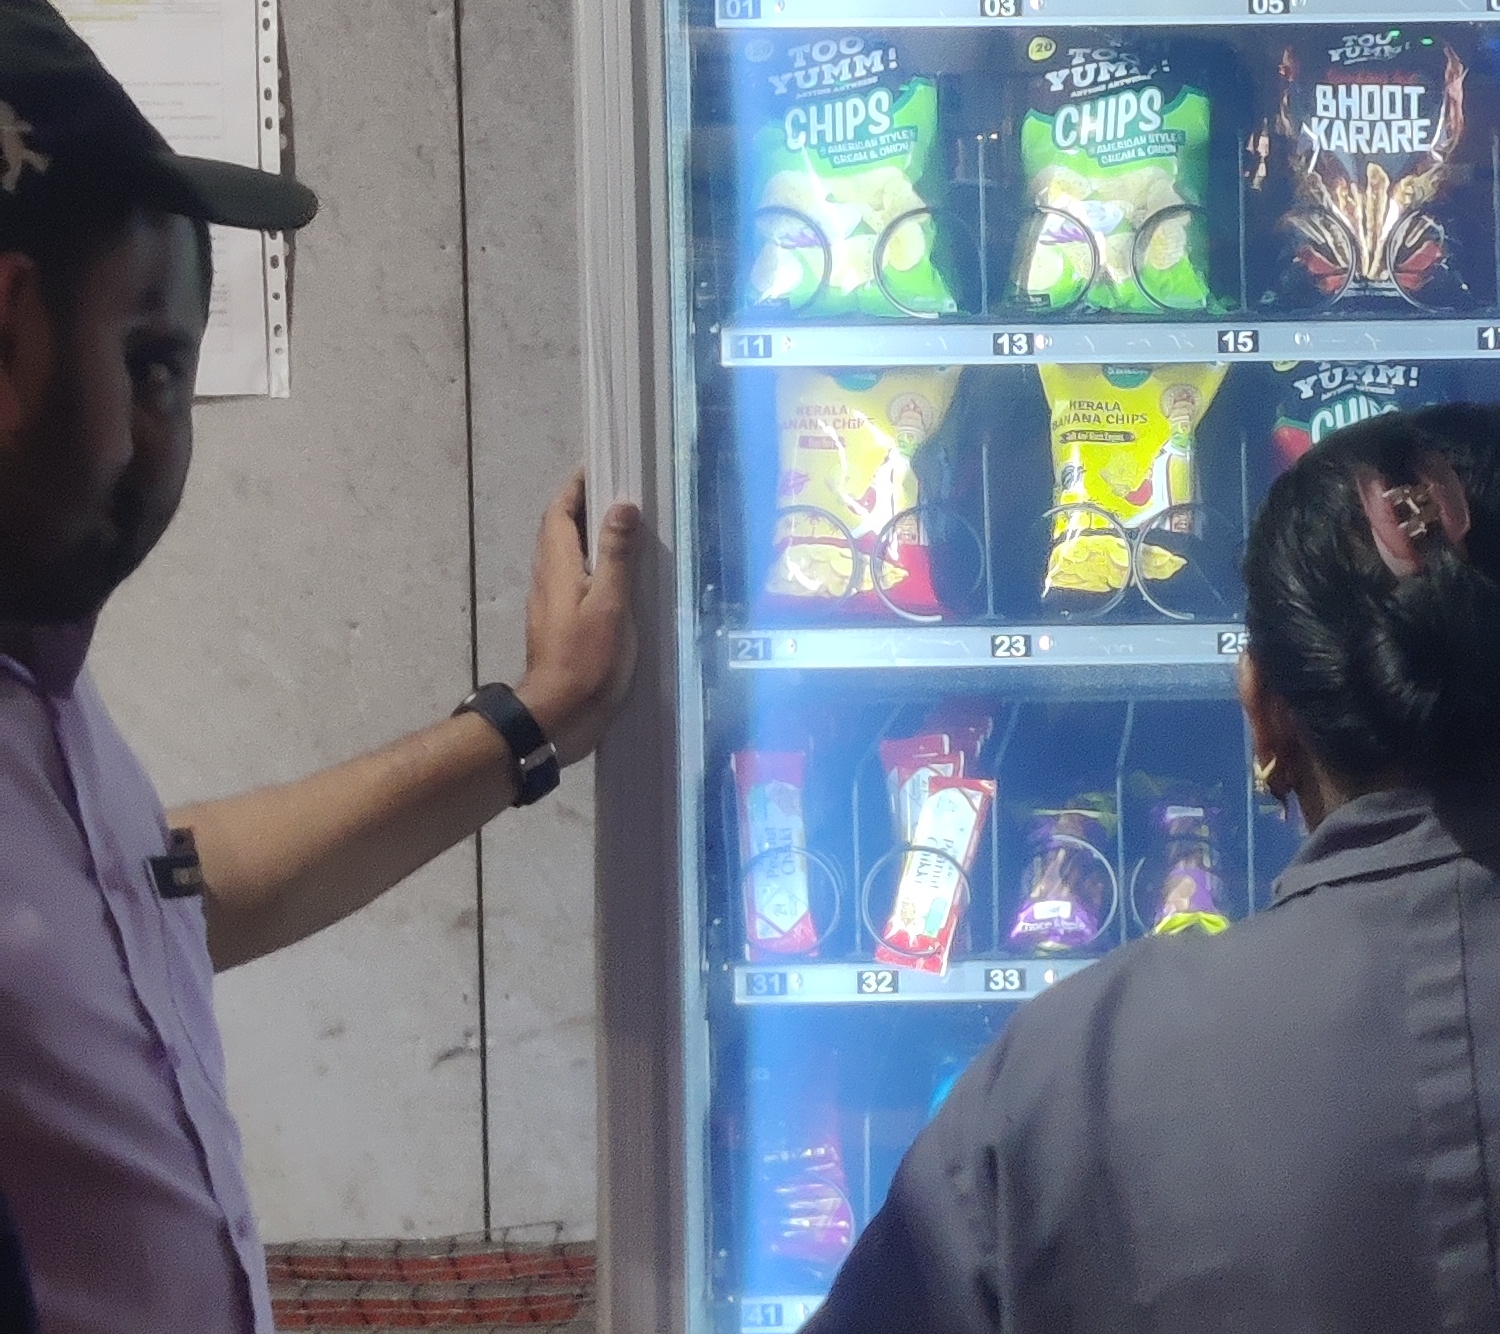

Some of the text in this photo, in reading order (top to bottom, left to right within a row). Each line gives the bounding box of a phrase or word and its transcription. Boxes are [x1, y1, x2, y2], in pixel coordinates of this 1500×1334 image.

[788, 36, 864, 67] TOO
[768, 48, 898, 95] YUMM!
[1316, 84, 1426, 120] BHOOT
[785, 91, 891, 150] CHIPS
[1055, 88, 1162, 147] CHIPS
[1311, 117, 1431, 154] KARARE
[737, 335, 765, 356] 11
[997, 333, 1028, 353] 13
[1222, 330, 1254, 352] 15
[1293, 365, 1418, 399] YUMM!
[1069, 400, 1121, 411] KERALA
[1106, 413, 1148, 424] CHIPS
[738, 640, 765, 659] 21
[995, 636, 1026, 656] 23
[1222, 633, 1250, 652] 25
[752, 975, 782, 993] 31
[862, 972, 894, 992] 32
[989, 969, 1020, 990] 33
